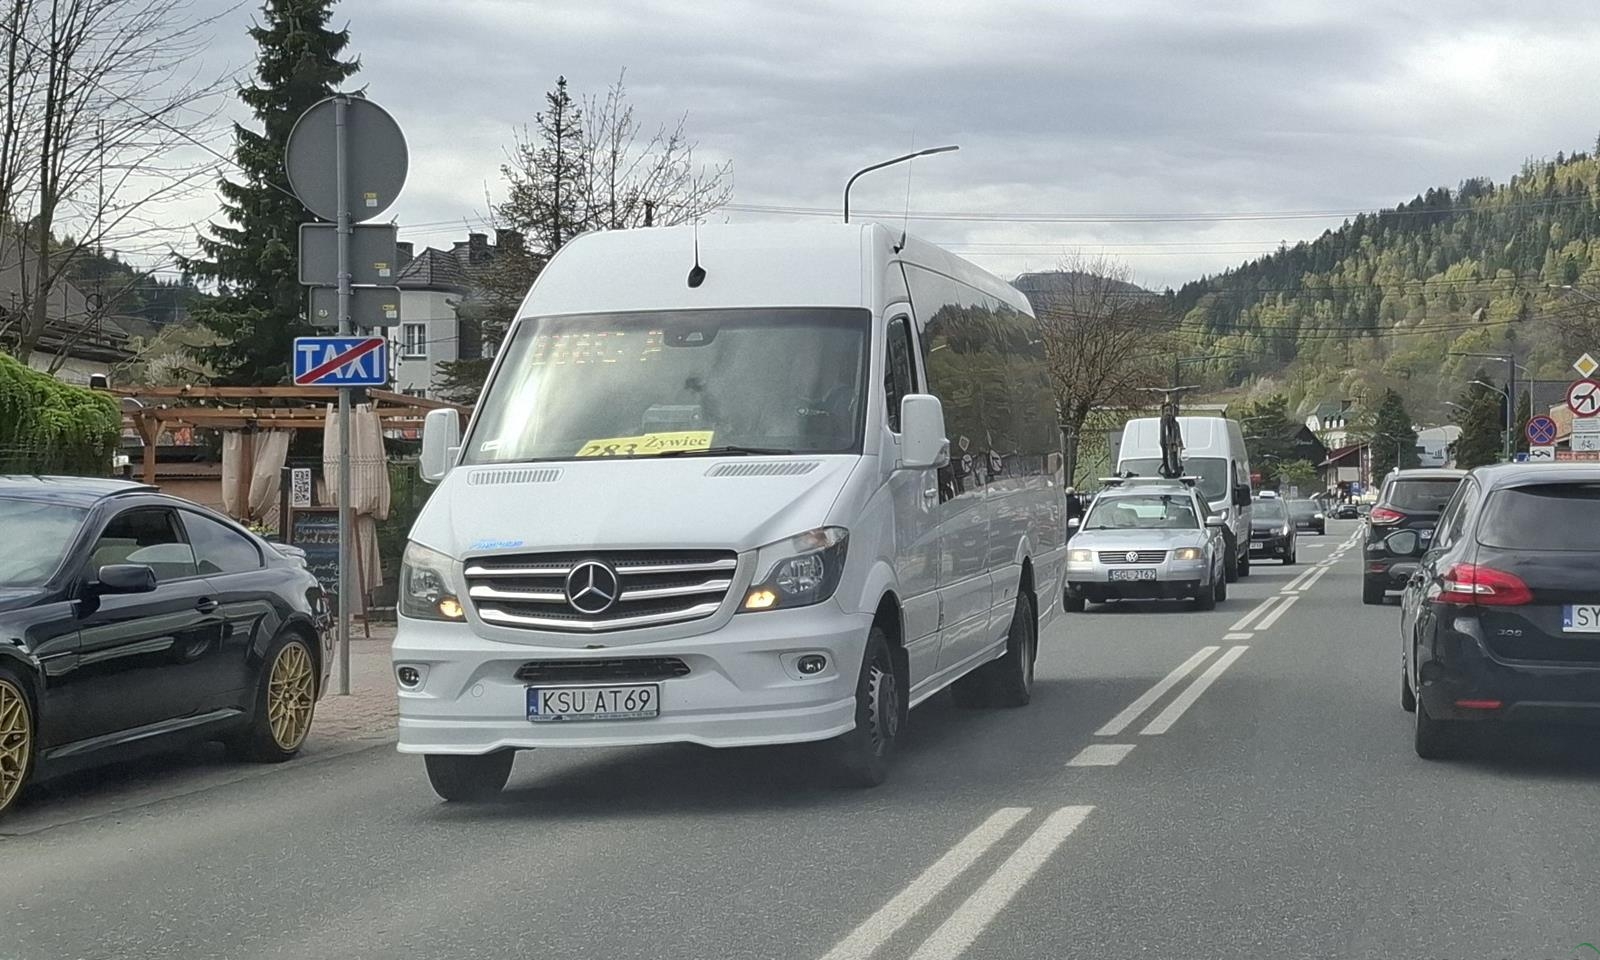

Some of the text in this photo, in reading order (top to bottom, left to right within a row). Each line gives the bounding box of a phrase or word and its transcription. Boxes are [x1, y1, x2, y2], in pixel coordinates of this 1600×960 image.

[298, 344, 380, 379] TAXI
[644, 436, 708, 449] Żywiec
[543, 689, 651, 714] KSU AT69
